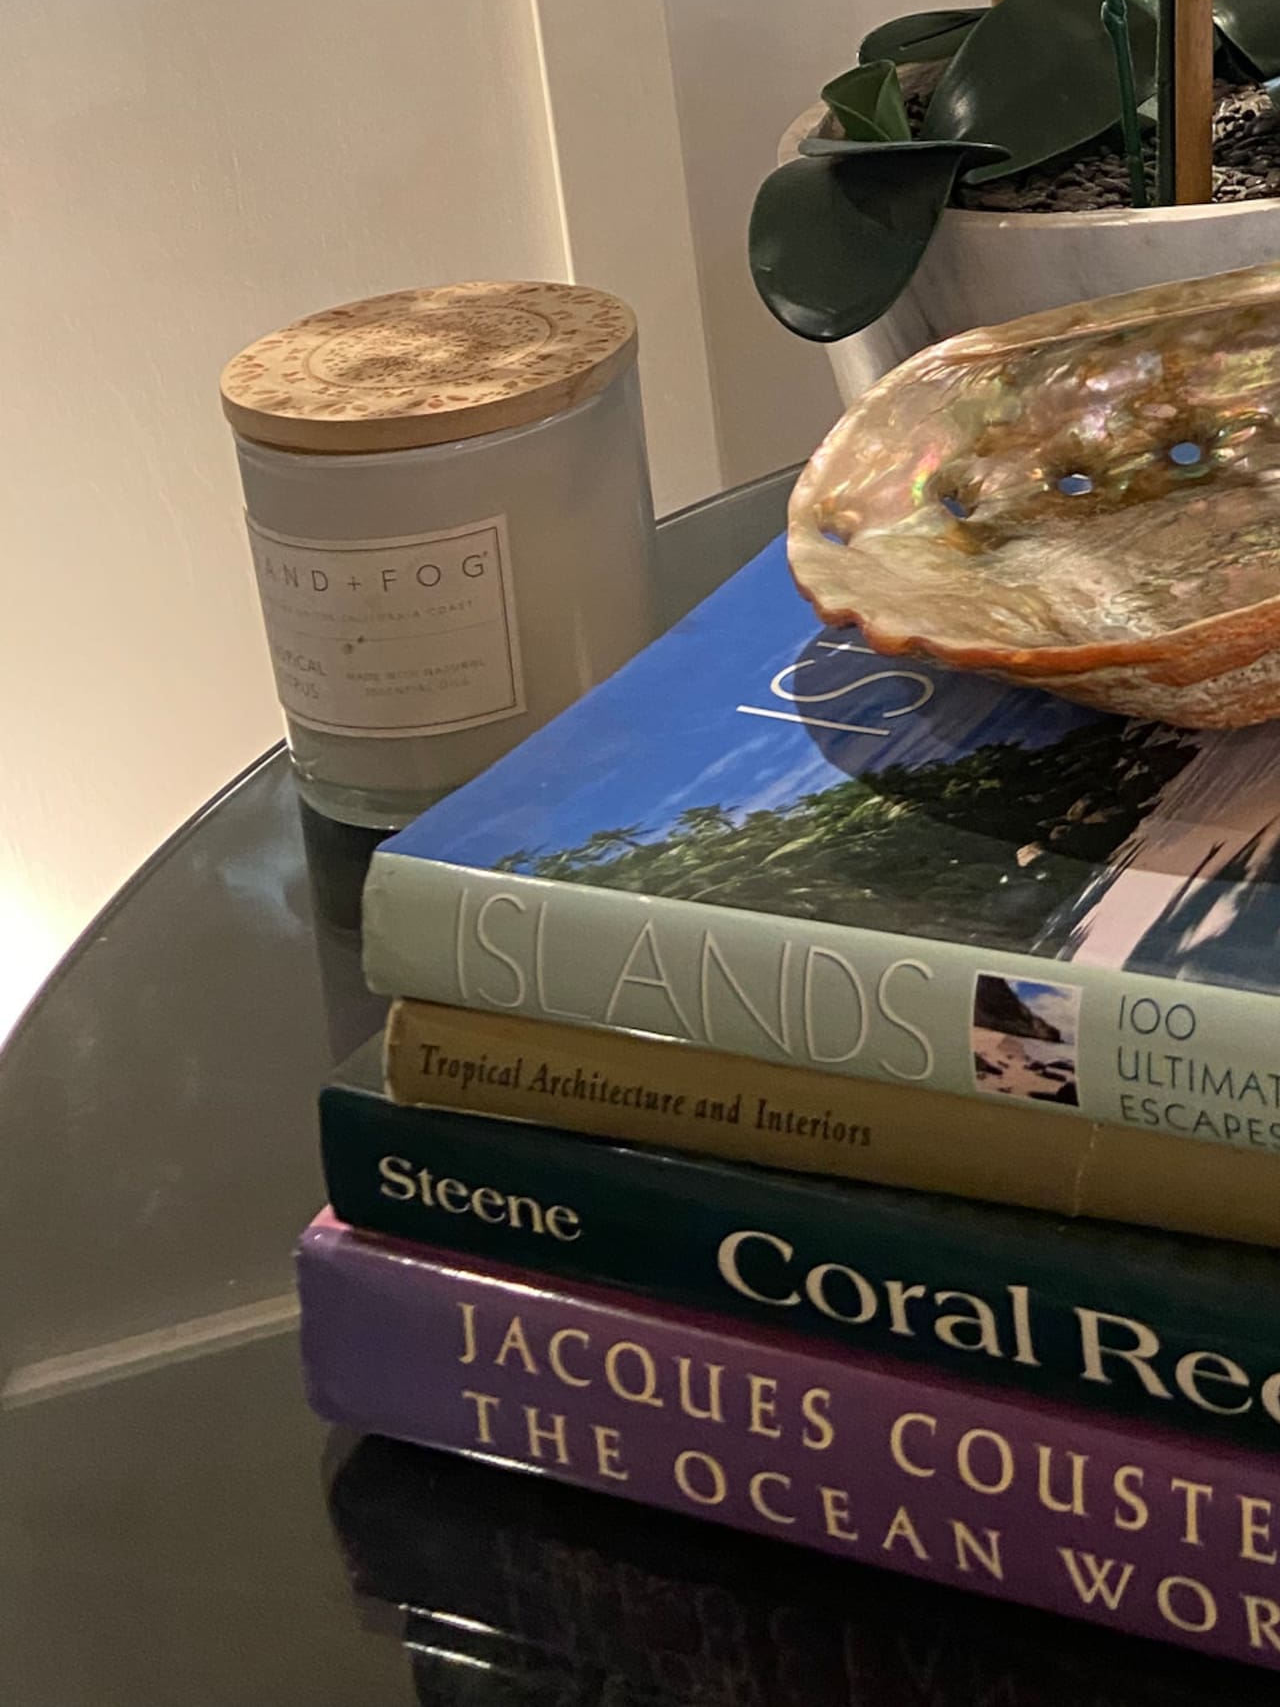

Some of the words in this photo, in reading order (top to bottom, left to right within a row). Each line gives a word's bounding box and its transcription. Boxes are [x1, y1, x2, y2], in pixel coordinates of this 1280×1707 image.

[264, 556, 329, 592] AND
[382, 554, 485, 592] FOG
[456, 889, 936, 1081] ISLANDS
[1118, 994, 1197, 1041] 100
[419, 1044, 520, 1090] Tropical
[528, 1062, 684, 1117] Architecture
[694, 1095, 740, 1125] and
[754, 1099, 871, 1146] Interiors
[378, 1155, 584, 1241] Steene
[717, 1230, 1042, 1367] Coral
[459, 1301, 837, 1452] JACQUES
[462, 1390, 629, 1481] THE
[673, 1449, 1005, 1581] OCEAN
